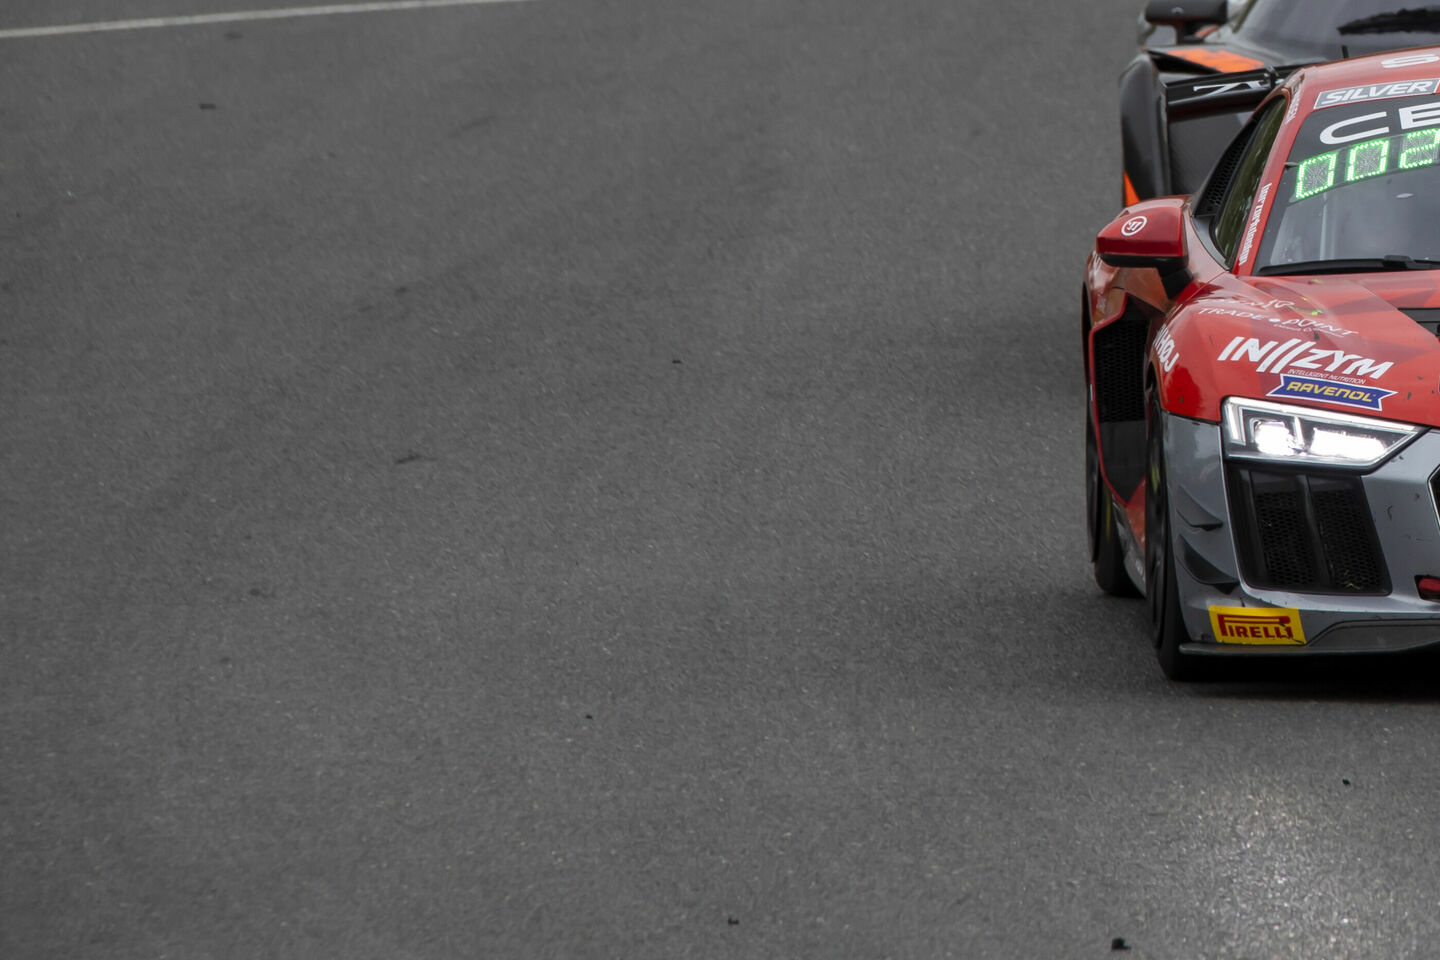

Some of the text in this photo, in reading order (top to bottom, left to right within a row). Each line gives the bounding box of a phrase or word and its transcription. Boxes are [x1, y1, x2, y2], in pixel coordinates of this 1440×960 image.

[1321, 80, 1433, 105] SILVER
[1287, 369, 1367, 385] INTELLIGENT NUTRITION
[1286, 381, 1374, 403] RAVENOL
[1217, 613, 1294, 639] PIRELLI
